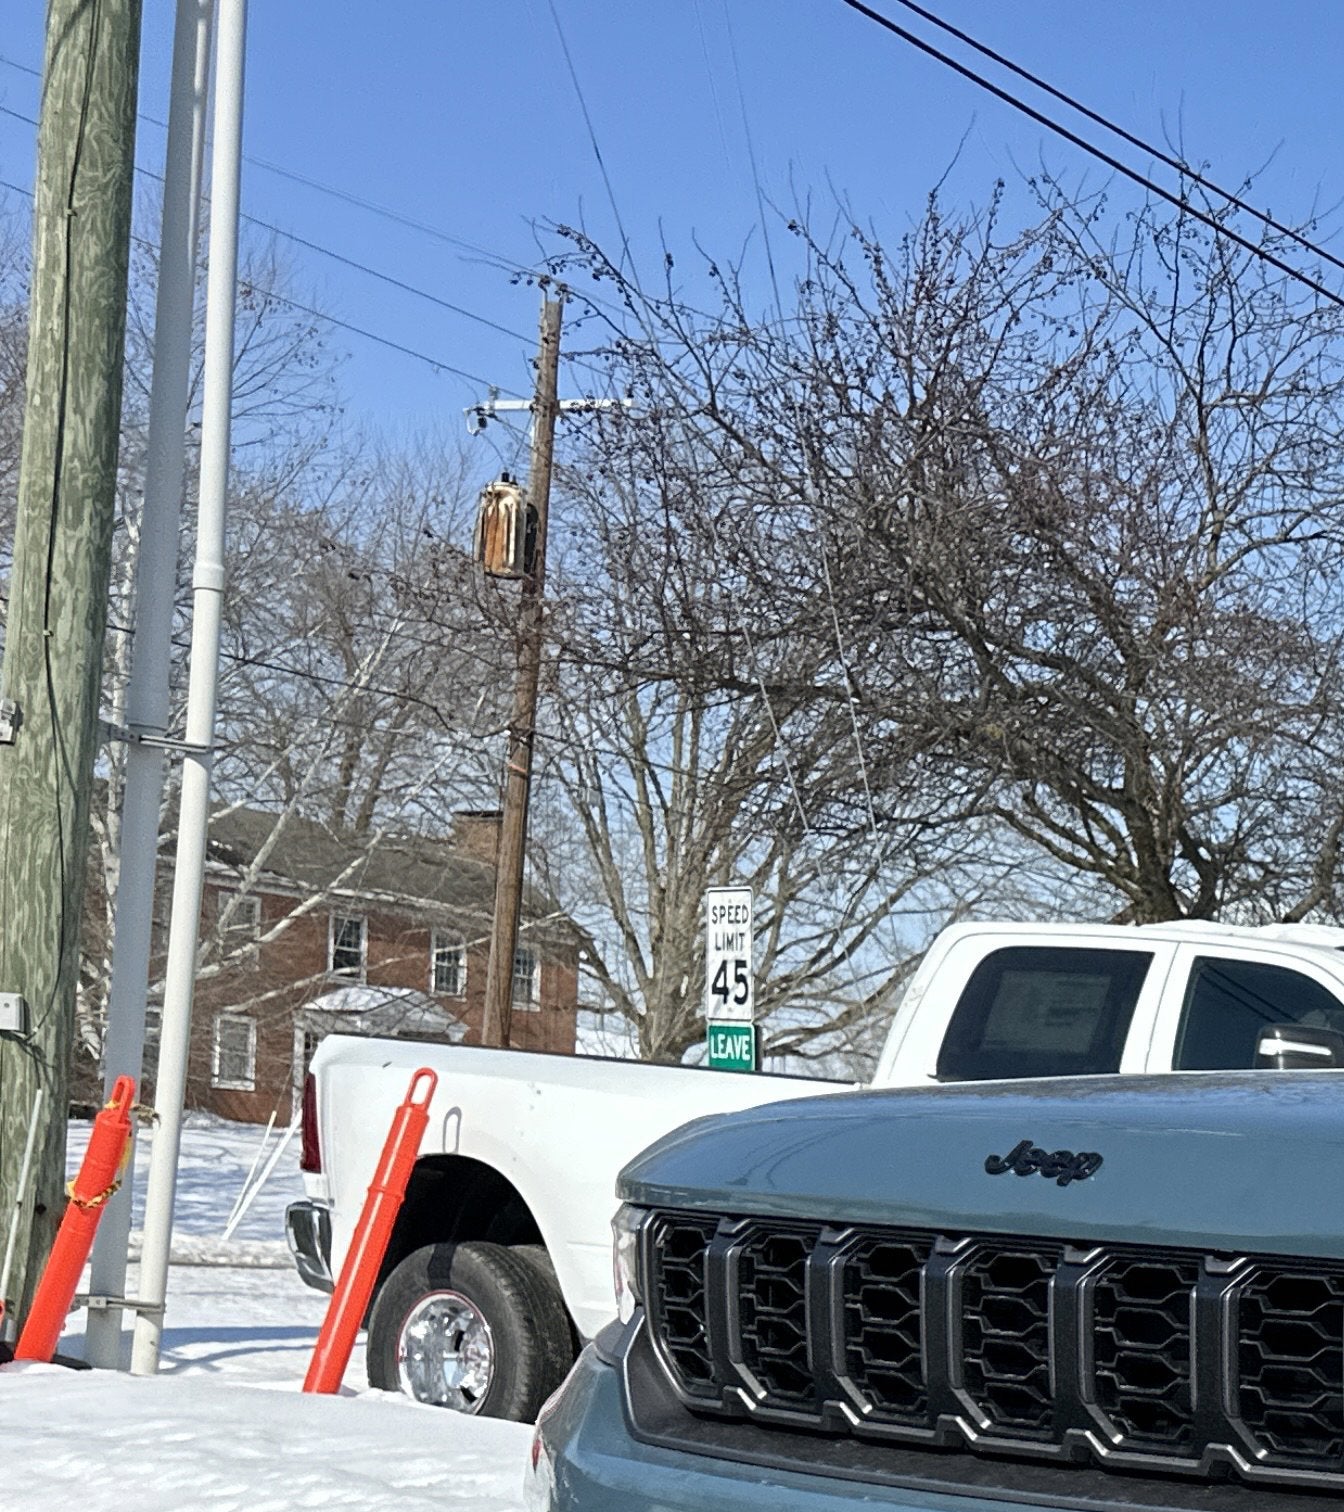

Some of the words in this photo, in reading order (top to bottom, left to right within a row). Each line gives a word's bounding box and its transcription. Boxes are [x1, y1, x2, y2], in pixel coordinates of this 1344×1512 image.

[711, 904, 749, 925] SPEED
[714, 932, 745, 951] LIMIT
[711, 959, 749, 1005] 45
[710, 1033, 750, 1061] LEAVE
[984, 1139, 1104, 1187] Jeep
